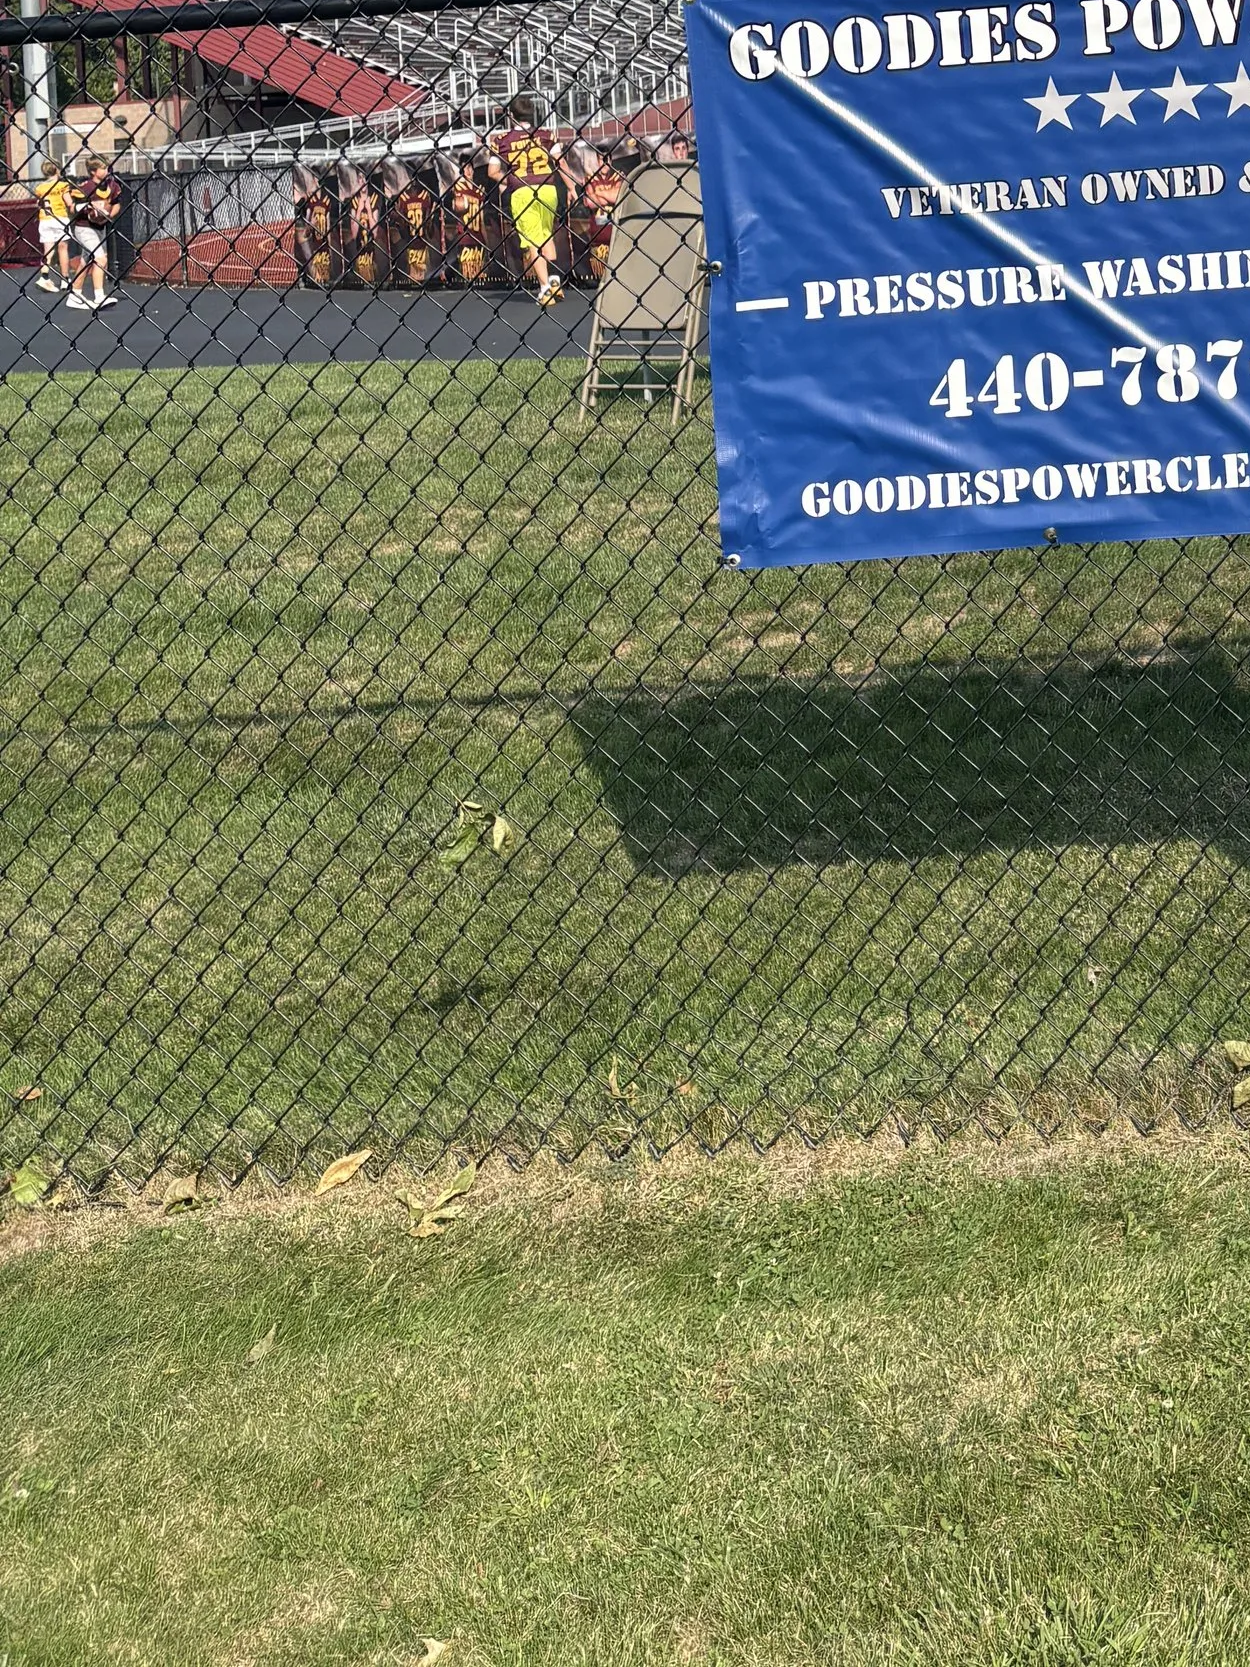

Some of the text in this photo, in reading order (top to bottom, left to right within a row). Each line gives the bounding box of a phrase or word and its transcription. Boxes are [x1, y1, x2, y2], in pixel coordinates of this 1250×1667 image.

[728, 0, 1059, 81] GOODIES
[508, 147, 553, 178] 72
[881, 175, 1069, 219] VETERAN
[1081, 164, 1226, 206] OWNED
[802, 263, 1067, 320] PRESSURE
